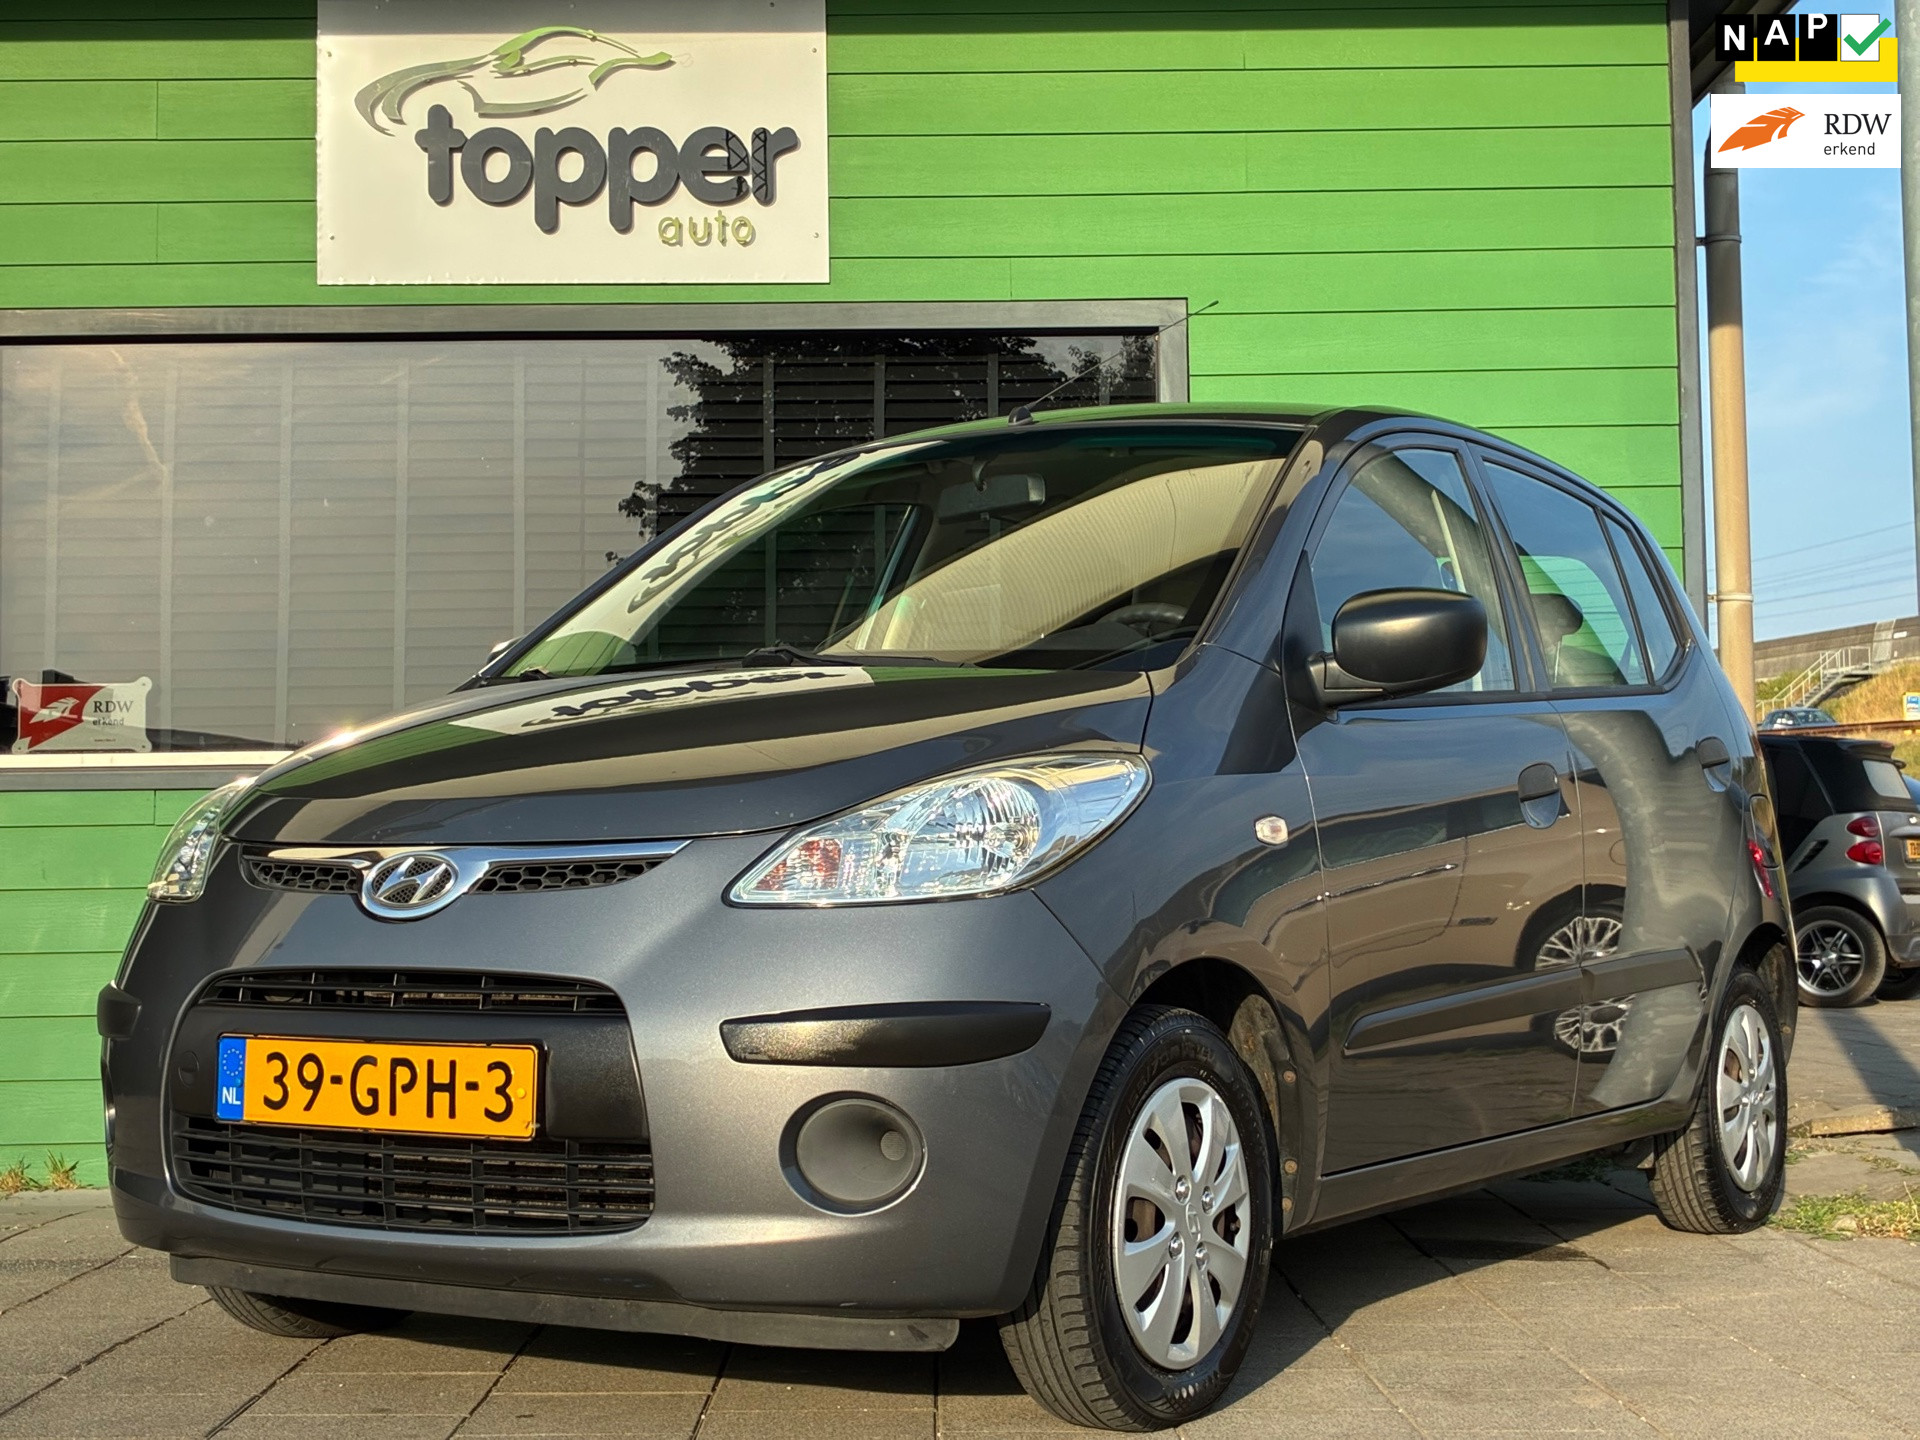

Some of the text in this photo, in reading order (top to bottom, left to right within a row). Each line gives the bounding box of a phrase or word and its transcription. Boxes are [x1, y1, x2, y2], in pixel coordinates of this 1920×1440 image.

[414, 103, 802, 235] topper
[657, 210, 756, 247] auto
[92, 700, 134, 713] RDW
[92, 717, 125, 726] erkend
[221, 1086, 242, 1105] NL
[262, 1051, 514, 1123] 39-GPH-3
